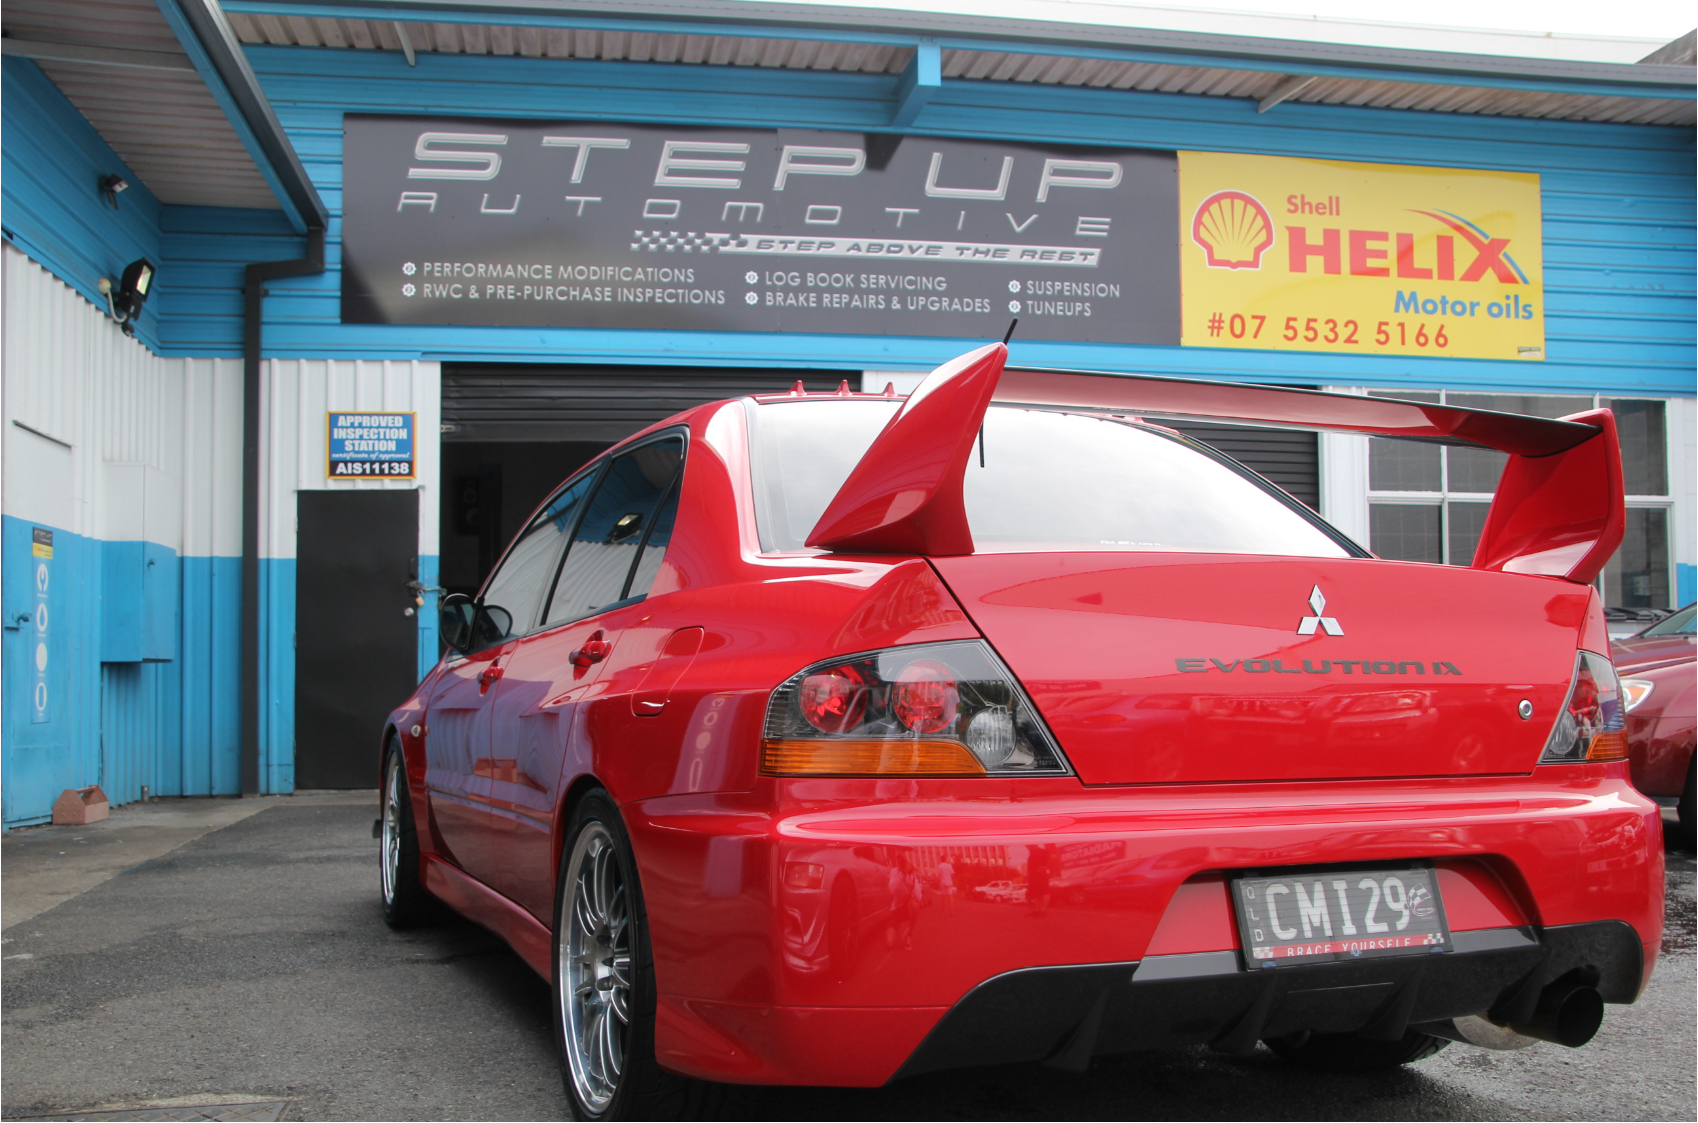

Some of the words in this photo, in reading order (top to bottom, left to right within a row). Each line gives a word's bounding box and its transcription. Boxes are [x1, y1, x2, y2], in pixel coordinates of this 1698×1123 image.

[407, 132, 867, 191] STEP
[924, 151, 1123, 202] UP
[397, 191, 1112, 237] AUTOMOTIVE
[1286, 194, 1340, 217] Shell
[756, 239, 836, 254] STEP
[846, 242, 944, 257] ABOVE
[955, 246, 1014, 260] THE
[1019, 249, 1095, 263] REST
[1284, 225, 1521, 285] HELIX
[423, 262, 553, 280] PERFORMANCE
[558, 265, 695, 283] MODIFICATIONS
[765, 271, 801, 287] LOG
[807, 272, 855, 289] BOOK
[860, 274, 947, 291] SERVICING
[423, 283, 466, 299] RWC
[469, 284, 479, 299] &
[486, 285, 613, 302] PRE-PURCHASE
[617, 287, 725, 304] INSPECTIONS
[1026, 280, 1120, 298] SUSPENSION
[765, 292, 818, 308] BRAKE
[823, 293, 886, 310] REPAIRS
[891, 296, 901, 310] &
[907, 296, 991, 313] UPGRADES
[1026, 301, 1092, 317] TUNEUPS
[1393, 290, 1480, 317] Motor
[1487, 294, 1534, 319] oils
[1207, 312, 1267, 340] #07
[1283, 316, 1359, 344] 5532
[1374, 321, 1449, 348] 5166
[337, 415, 403, 427] APPROVED
[333, 427, 408, 440] INSPECTION
[344, 439, 397, 451] STATION
[335, 462, 410, 475] AIS11138
[1175, 658, 1425, 675] EVOLUTION
[1265, 877, 1411, 941] CMI29
